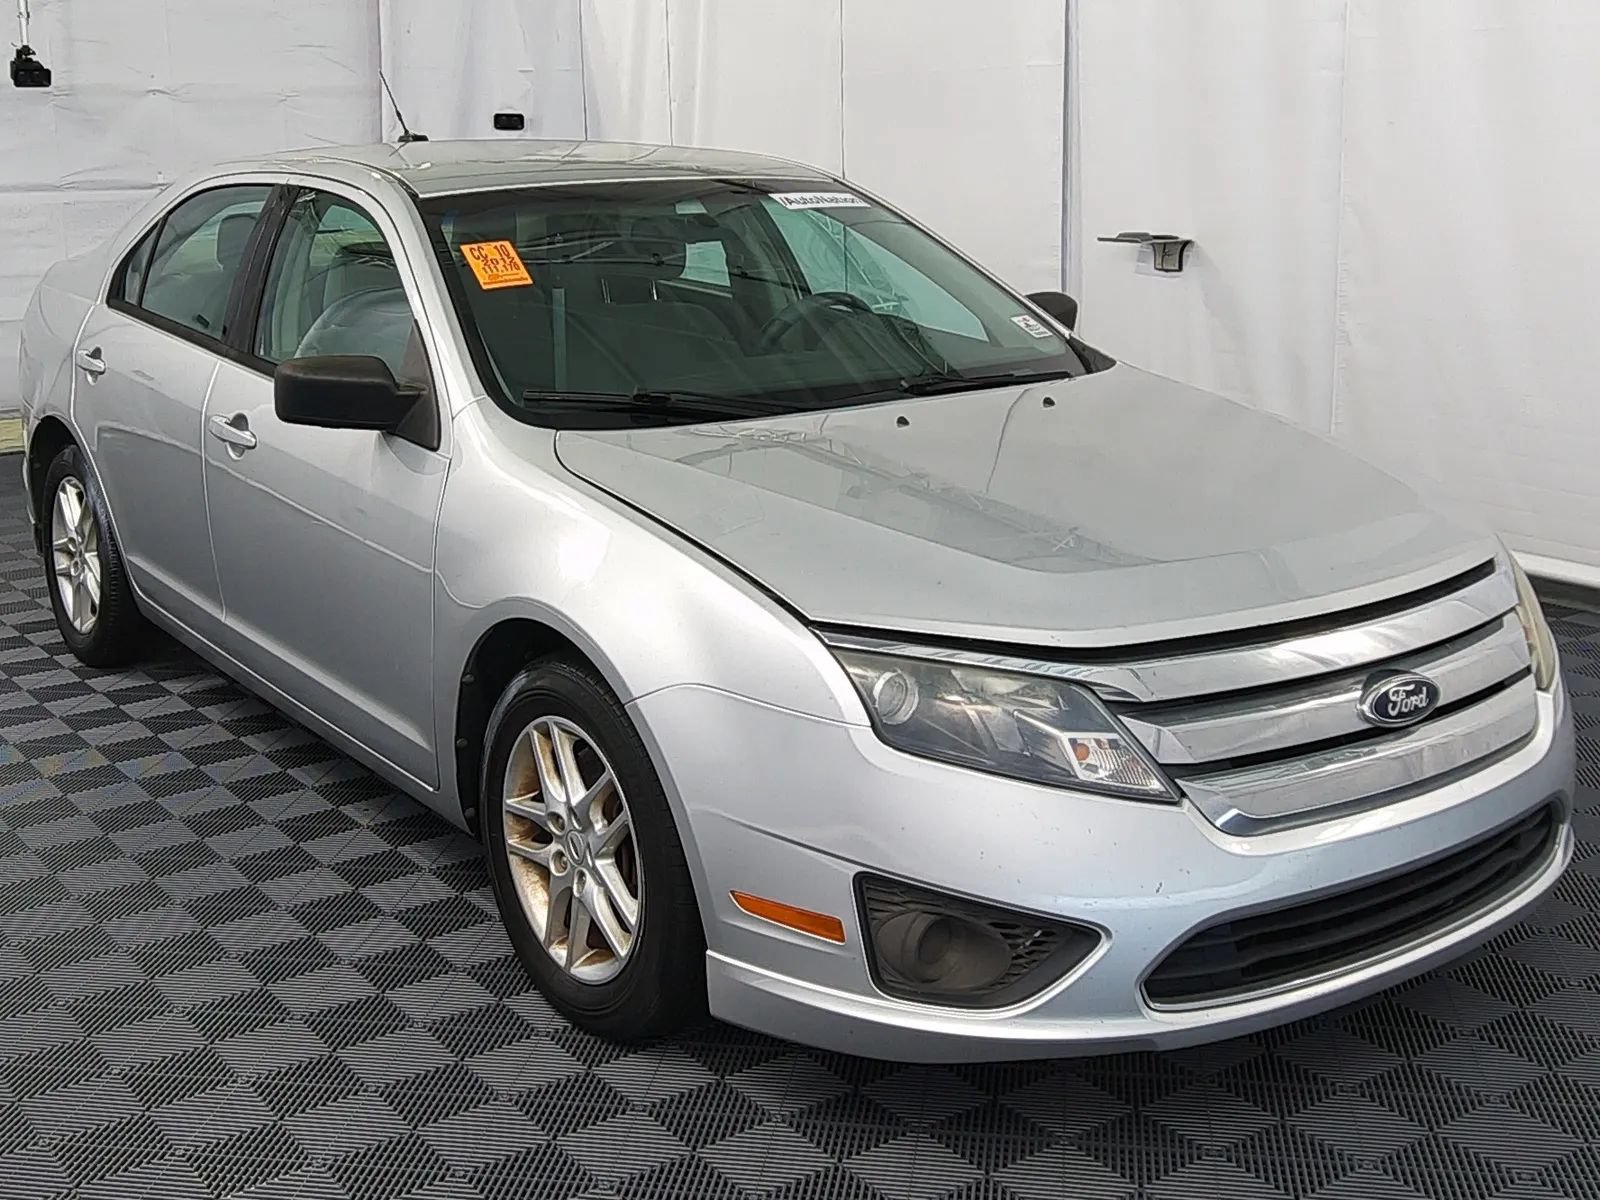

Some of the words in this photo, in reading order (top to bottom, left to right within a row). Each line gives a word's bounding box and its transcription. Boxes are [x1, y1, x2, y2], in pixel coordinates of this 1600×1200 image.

[469, 245, 488, 261] CC
[493, 243, 511, 259] 10
[1387, 684, 1429, 716] Ford
